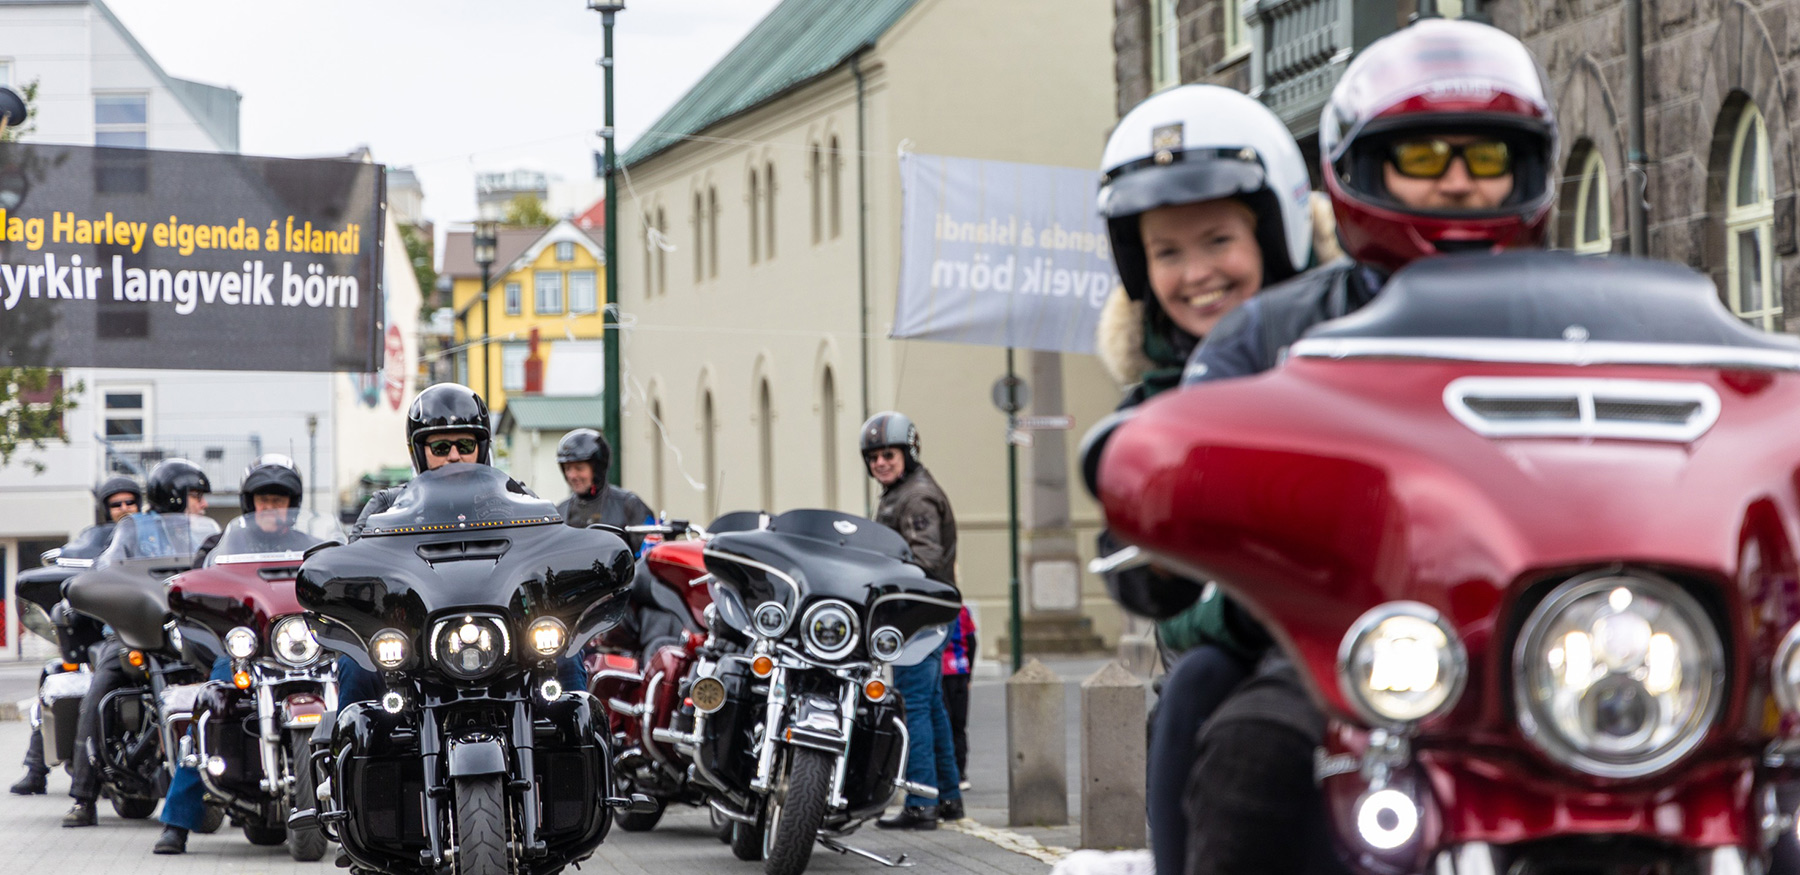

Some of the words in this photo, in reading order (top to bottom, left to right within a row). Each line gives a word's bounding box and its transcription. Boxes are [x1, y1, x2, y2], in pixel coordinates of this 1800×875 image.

[52, 211, 147, 254] Harley
[152, 216, 260, 256] eigenda
[264, 220, 279, 251] á
[285, 216, 360, 255] Íslandi
[0, 252, 103, 310] yrkir
[112, 254, 274, 314] langveik
[281, 261, 359, 309] börn
